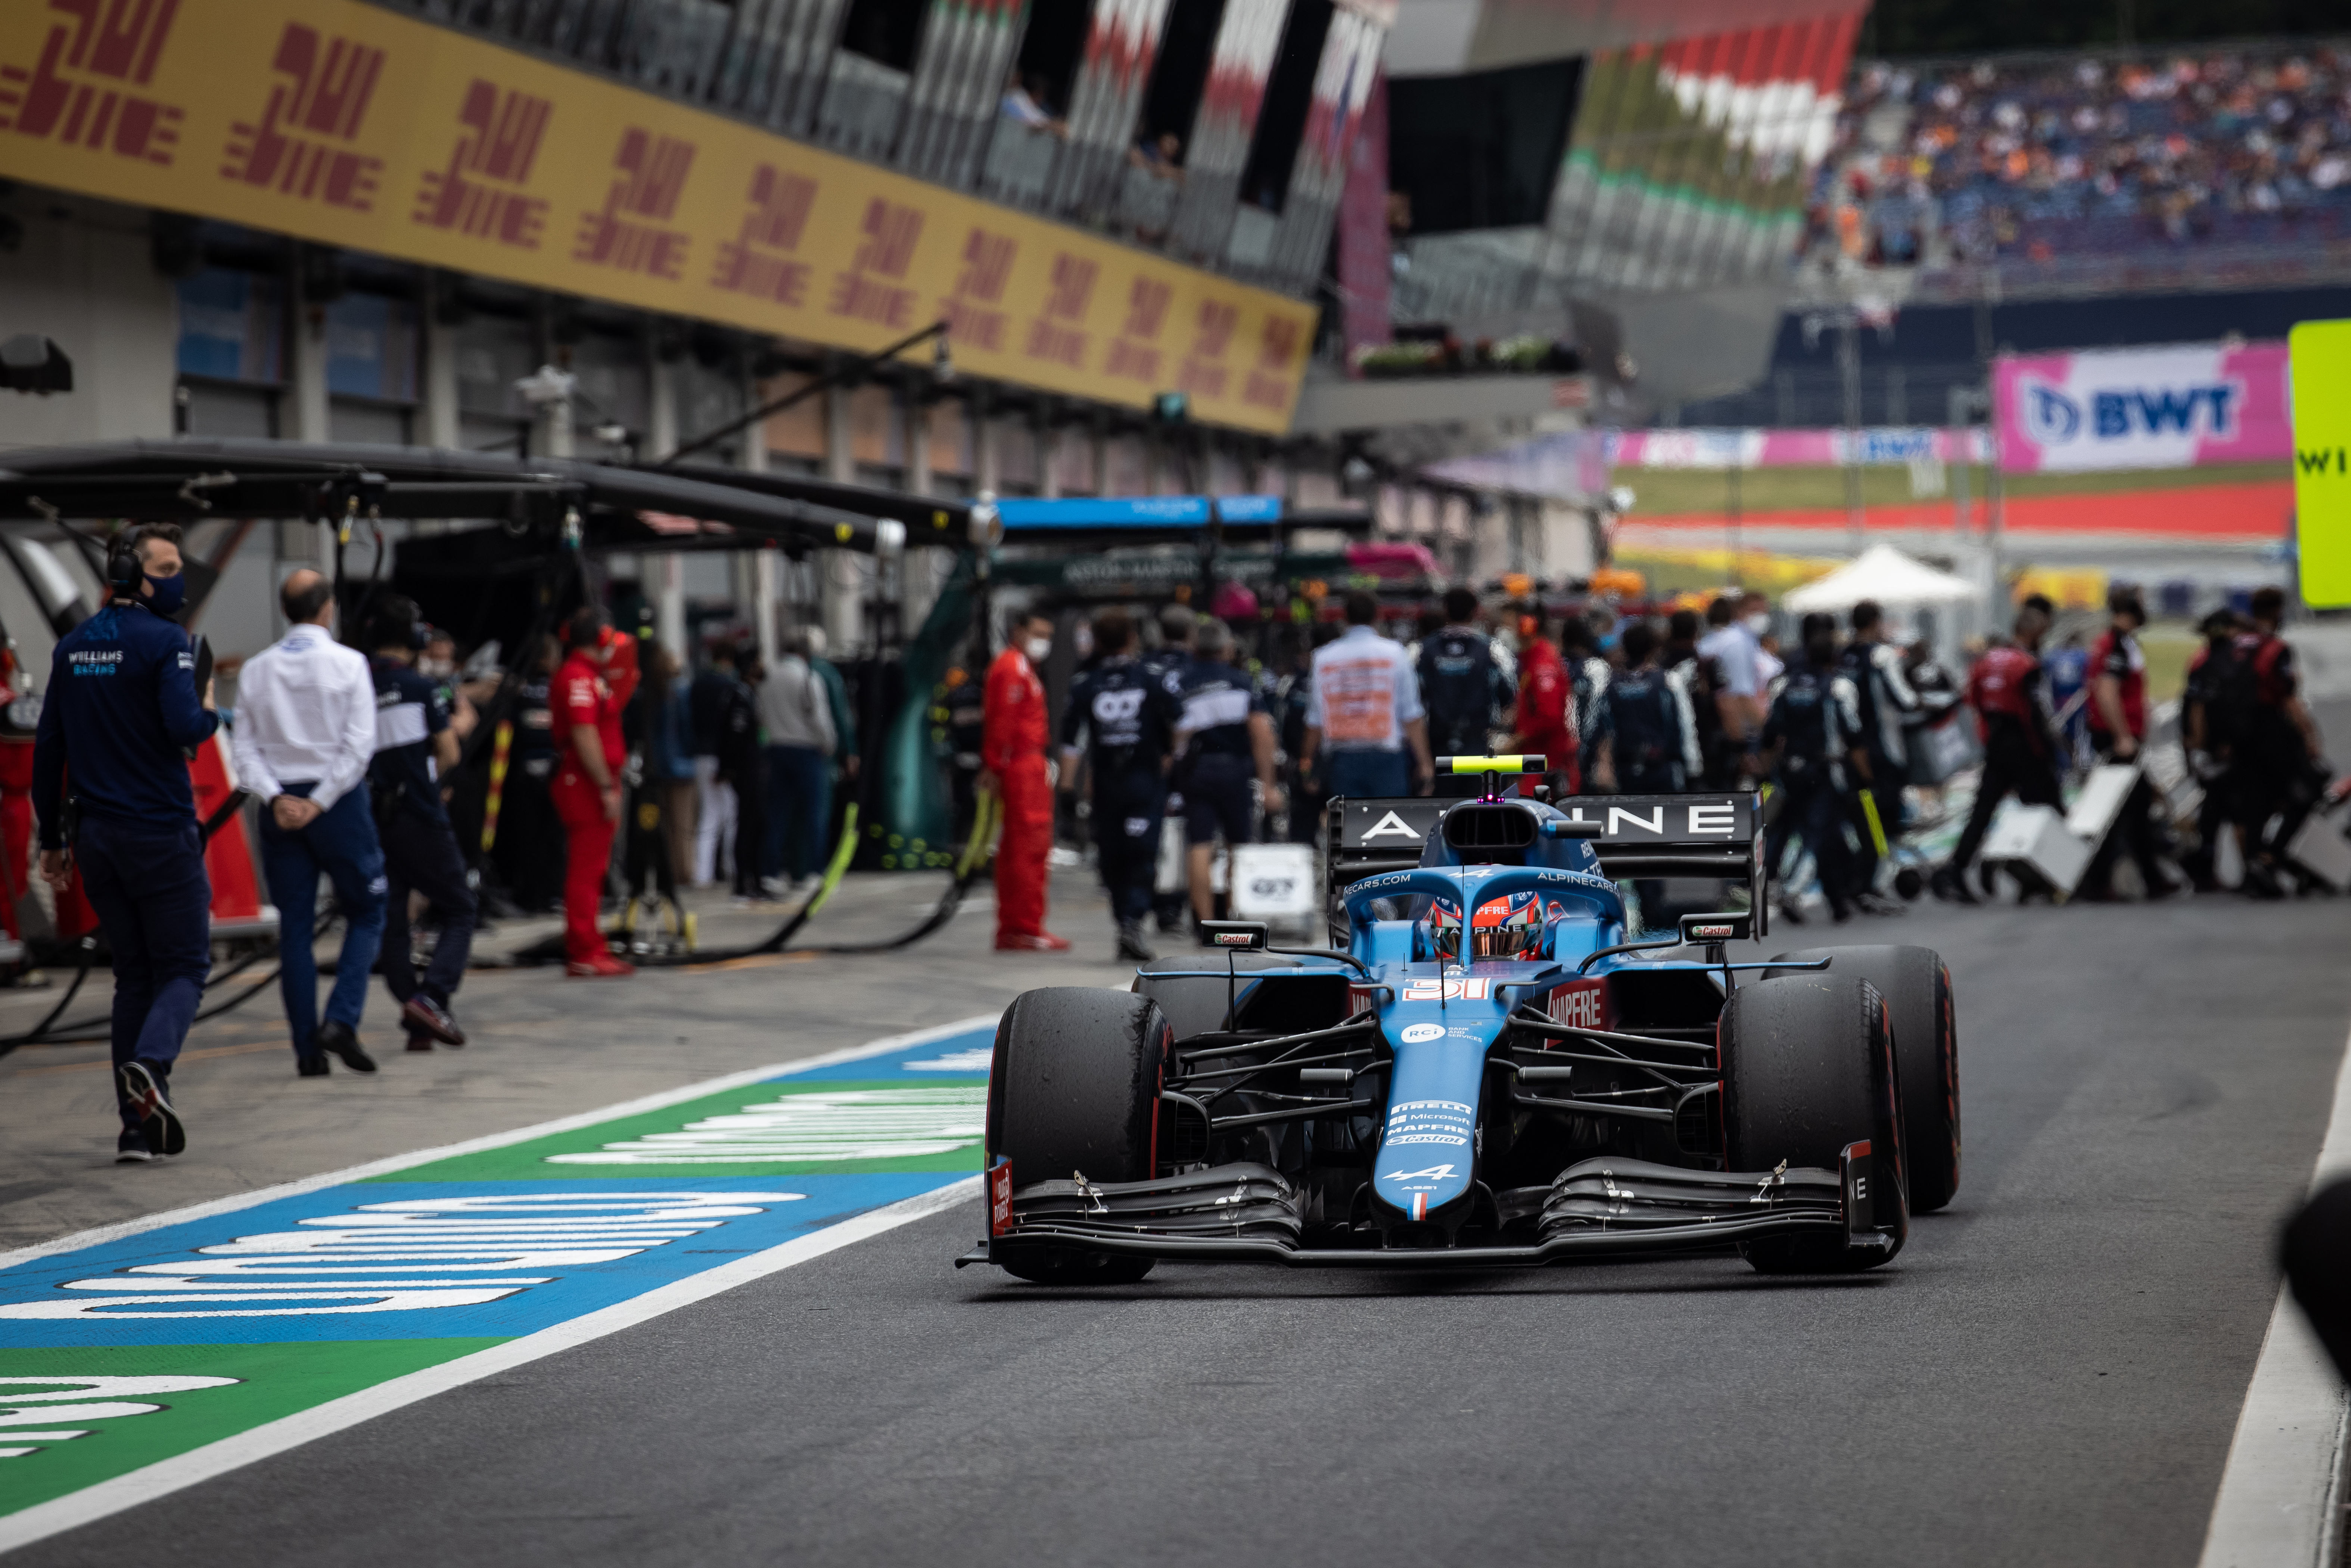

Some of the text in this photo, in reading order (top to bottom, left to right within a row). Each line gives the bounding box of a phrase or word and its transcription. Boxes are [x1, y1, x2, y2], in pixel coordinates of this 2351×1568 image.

[2094, 386, 2233, 438] BWT
[69, 651, 124, 664] WILLIAMS
[74, 663, 116, 676] RACING
[1450, 924, 1521, 934] APINE
[1703, 926, 1732, 936] Castrol
[1222, 935, 1250, 944] Castrol
[1402, 977, 1491, 1001] 31
[1552, 988, 1601, 1027] MAPFRE
[1448, 1033, 1483, 1043] SERVICES
[1391, 1100, 1472, 1115] PIRELLI
[1411, 1113, 1471, 1126] Microsoft
[1387, 1124, 1469, 1137] MAPFRE
[1405, 1135, 1462, 1144] Castrol
